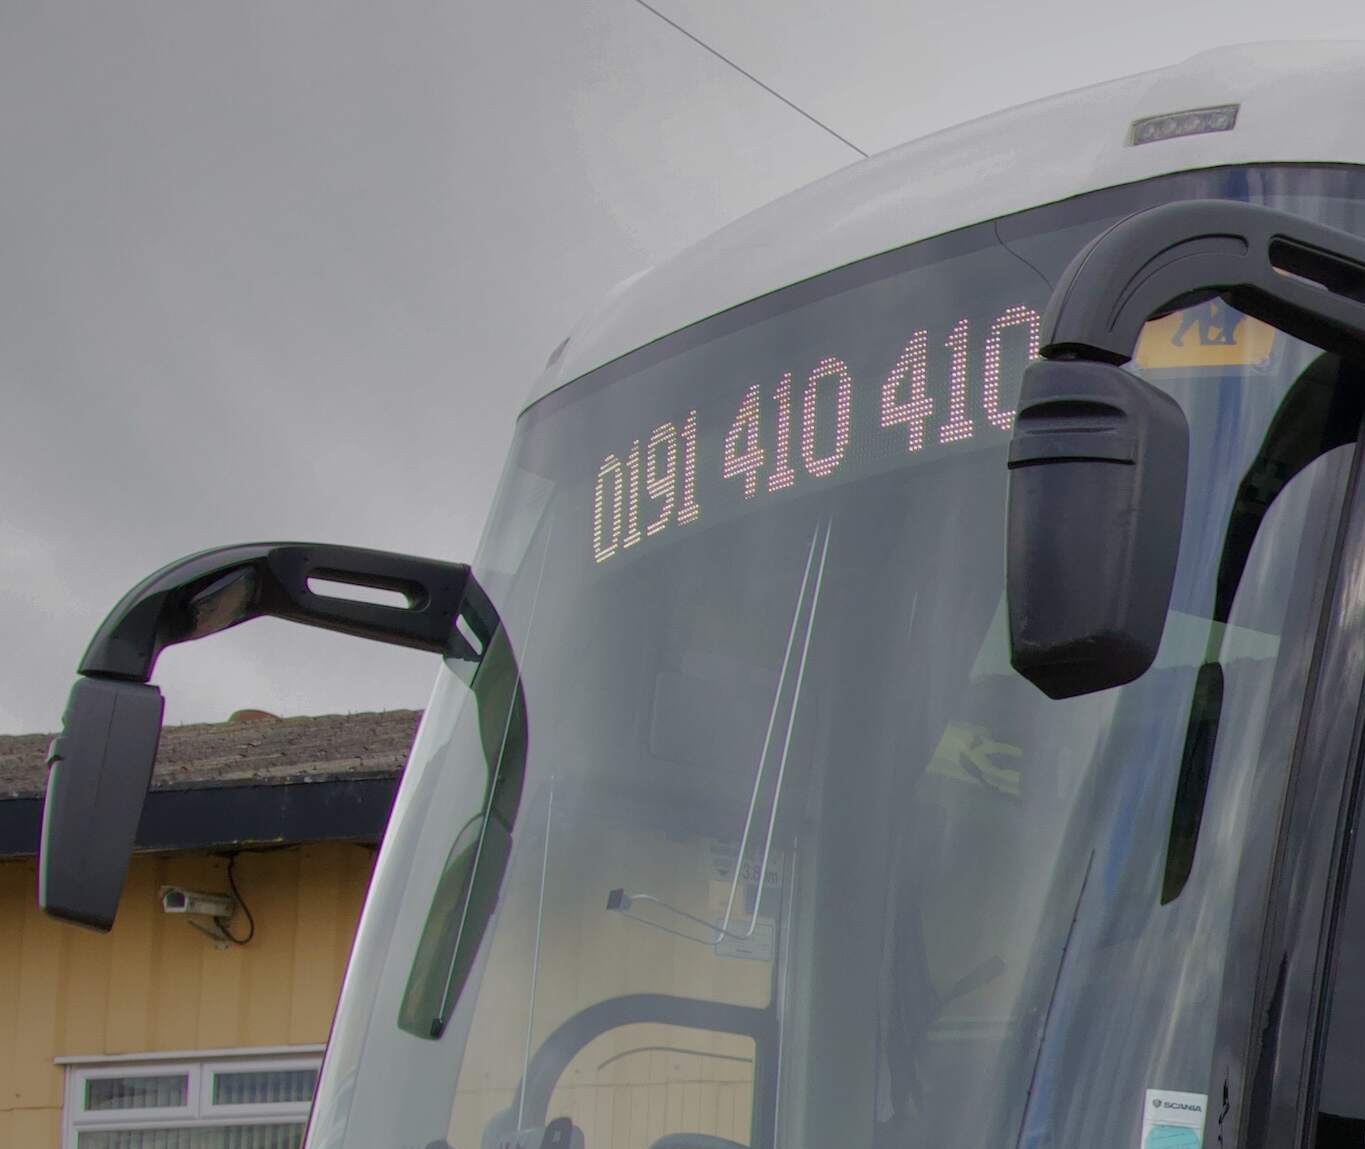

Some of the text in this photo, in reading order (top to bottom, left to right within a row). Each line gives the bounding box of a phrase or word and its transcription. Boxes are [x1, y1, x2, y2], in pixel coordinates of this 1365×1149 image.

[593, 408, 699, 564] 0191
[722, 357, 852, 501] 410
[1163, 1101, 1203, 1113] SCANIA
